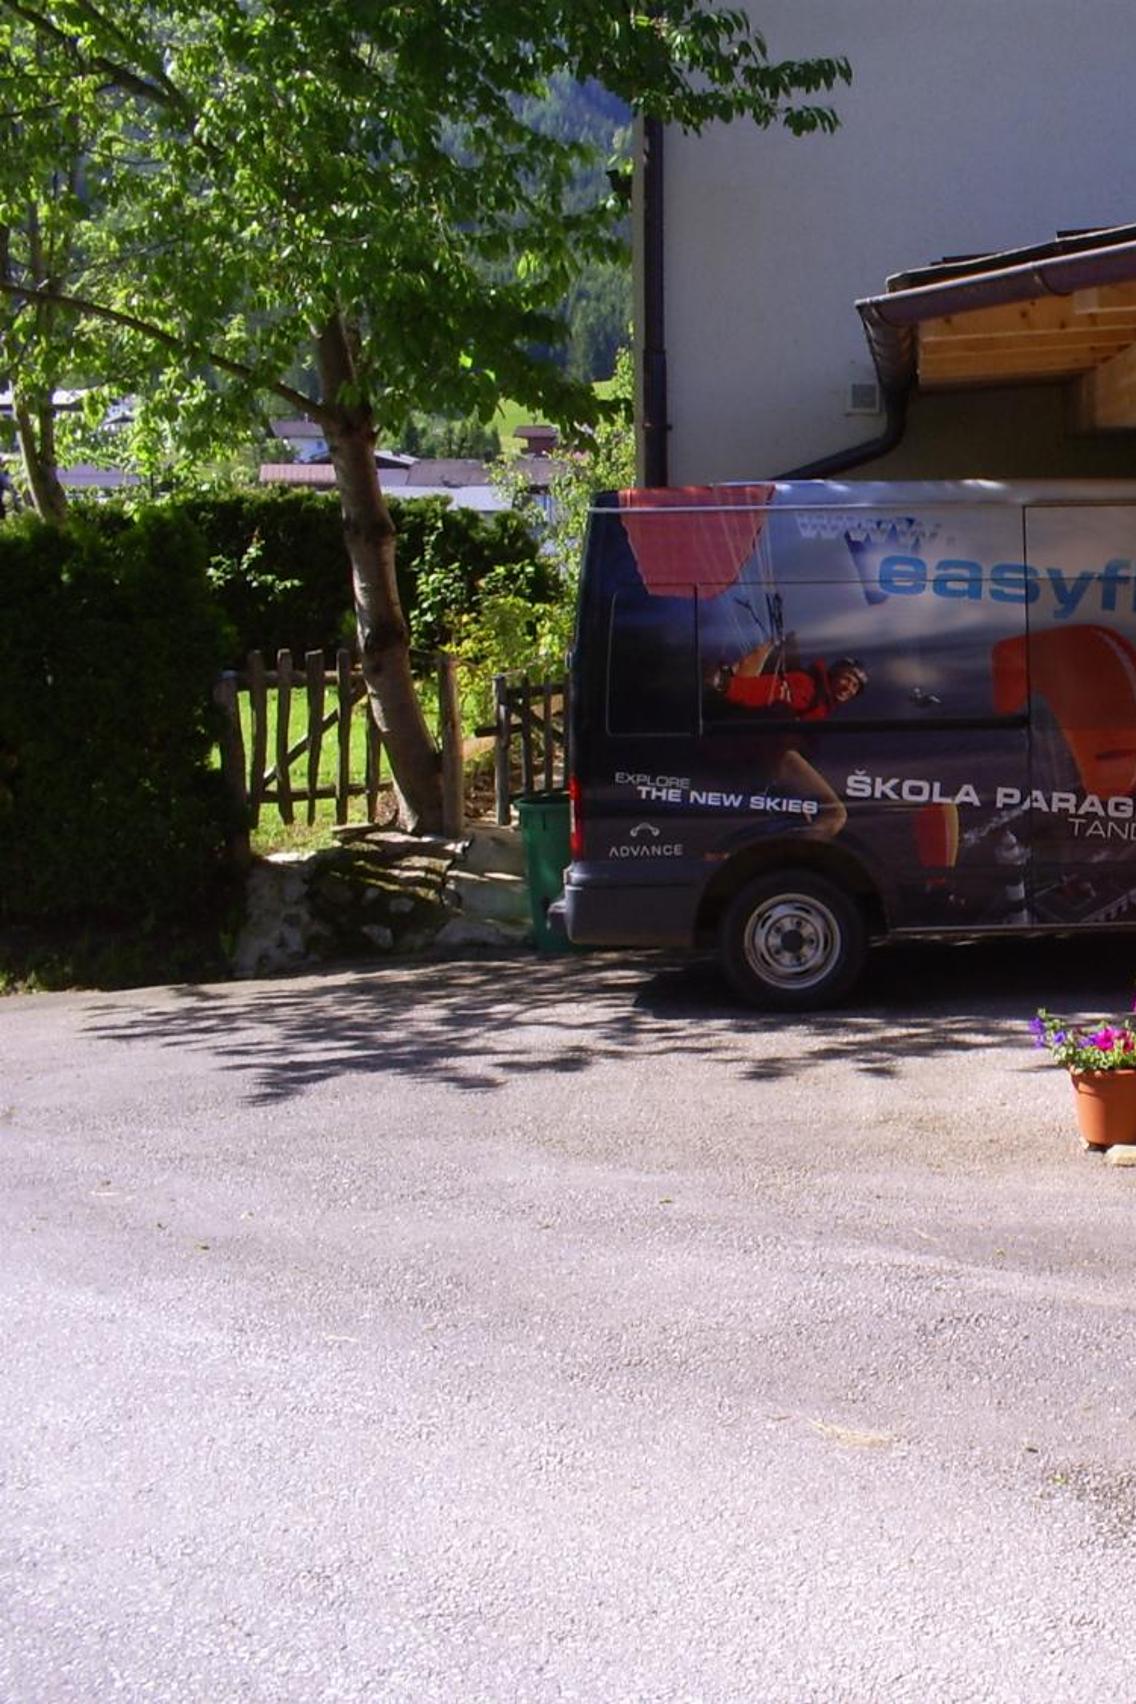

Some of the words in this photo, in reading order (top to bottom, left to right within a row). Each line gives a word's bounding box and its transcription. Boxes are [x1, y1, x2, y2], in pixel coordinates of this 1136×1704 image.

[614, 772, 691, 790] EXPLORE
[845, 768, 980, 808] ŠKOLA
[637, 785, 682, 802] THE
[689, 790, 742, 808] NEW
[749, 795, 819, 815] SKIES
[608, 843, 684, 859] ADVANCE
